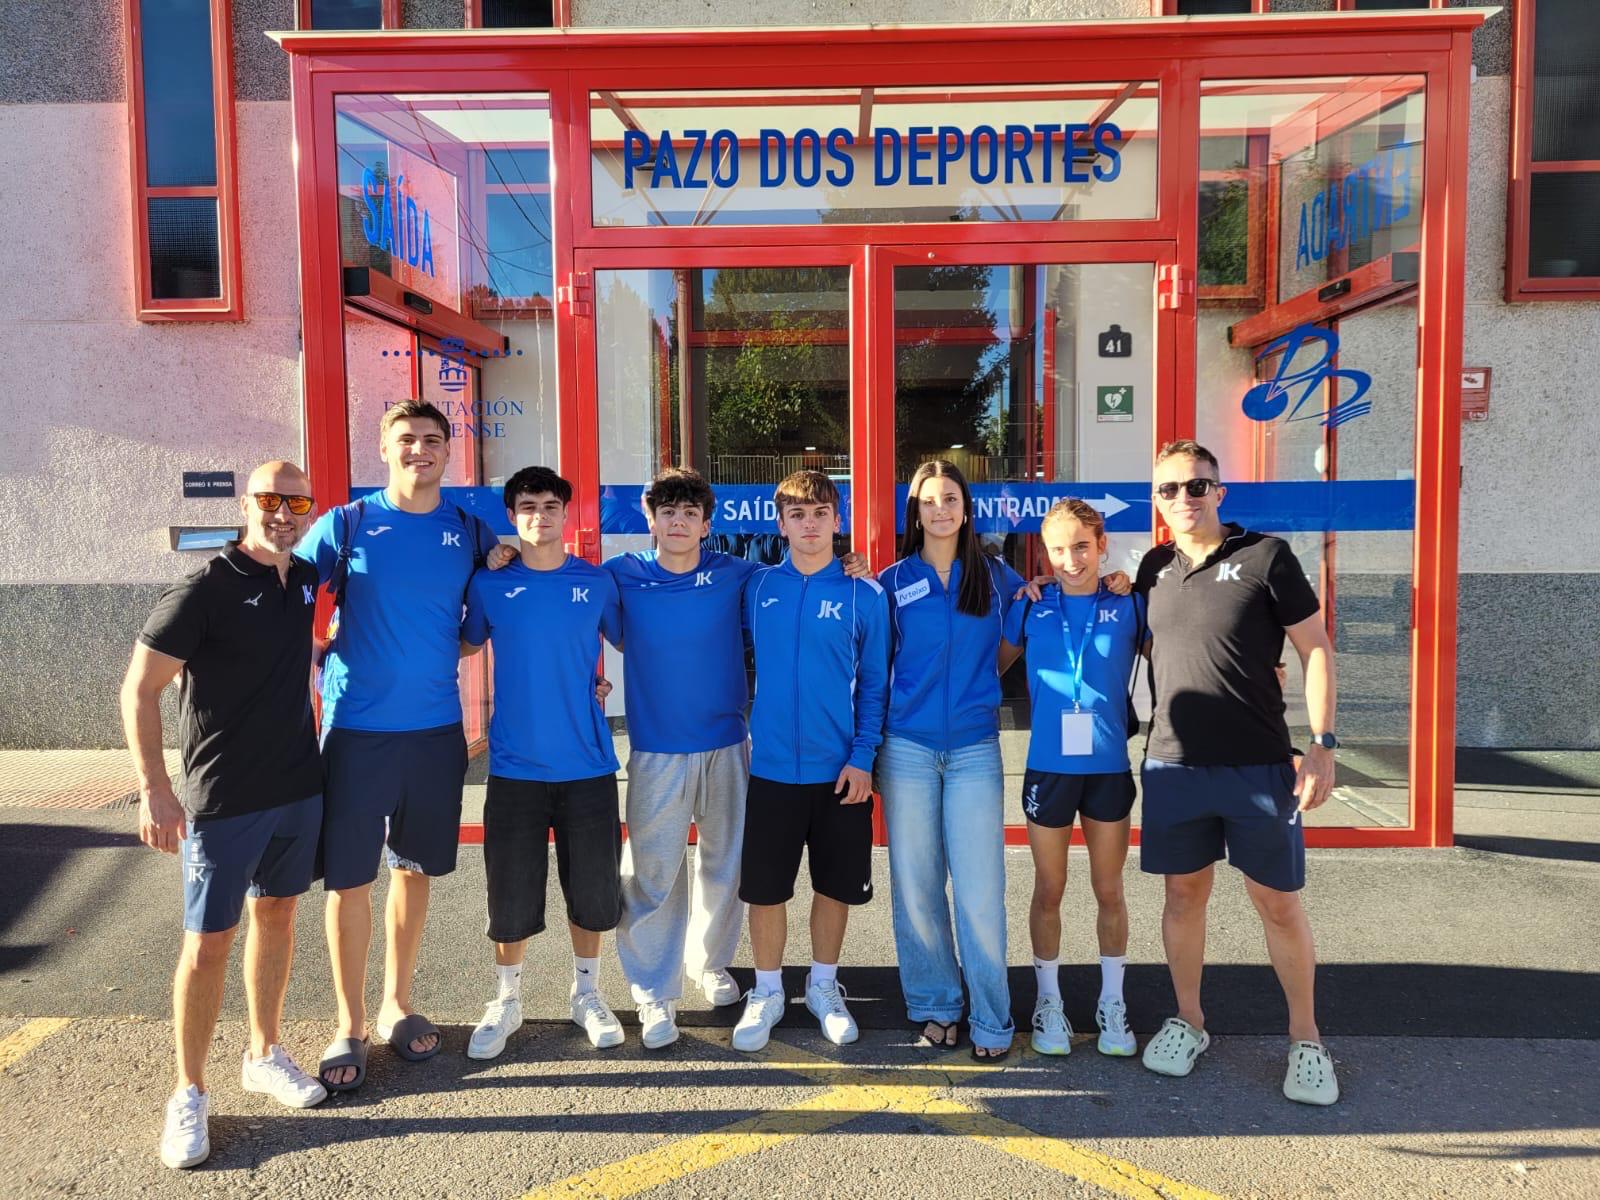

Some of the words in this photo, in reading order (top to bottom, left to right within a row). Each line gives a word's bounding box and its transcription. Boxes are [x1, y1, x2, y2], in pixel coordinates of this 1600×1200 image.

[623, 129, 739, 189] PAZO
[760, 128, 854, 188] DOS
[874, 123, 1122, 186] DEPORTES
[362, 167, 435, 278] SAÍDA
[1105, 339, 1122, 353] 41
[451, 423, 505, 437] ENSE
[723, 496, 779, 520] SAÍD
[441, 531, 461, 547] JK
[694, 571, 713, 587] JK
[1215, 562, 1242, 582] JK
[571, 587, 590, 603] JK
[816, 599, 844, 620] JK
[1098, 609, 1119, 624] JK
